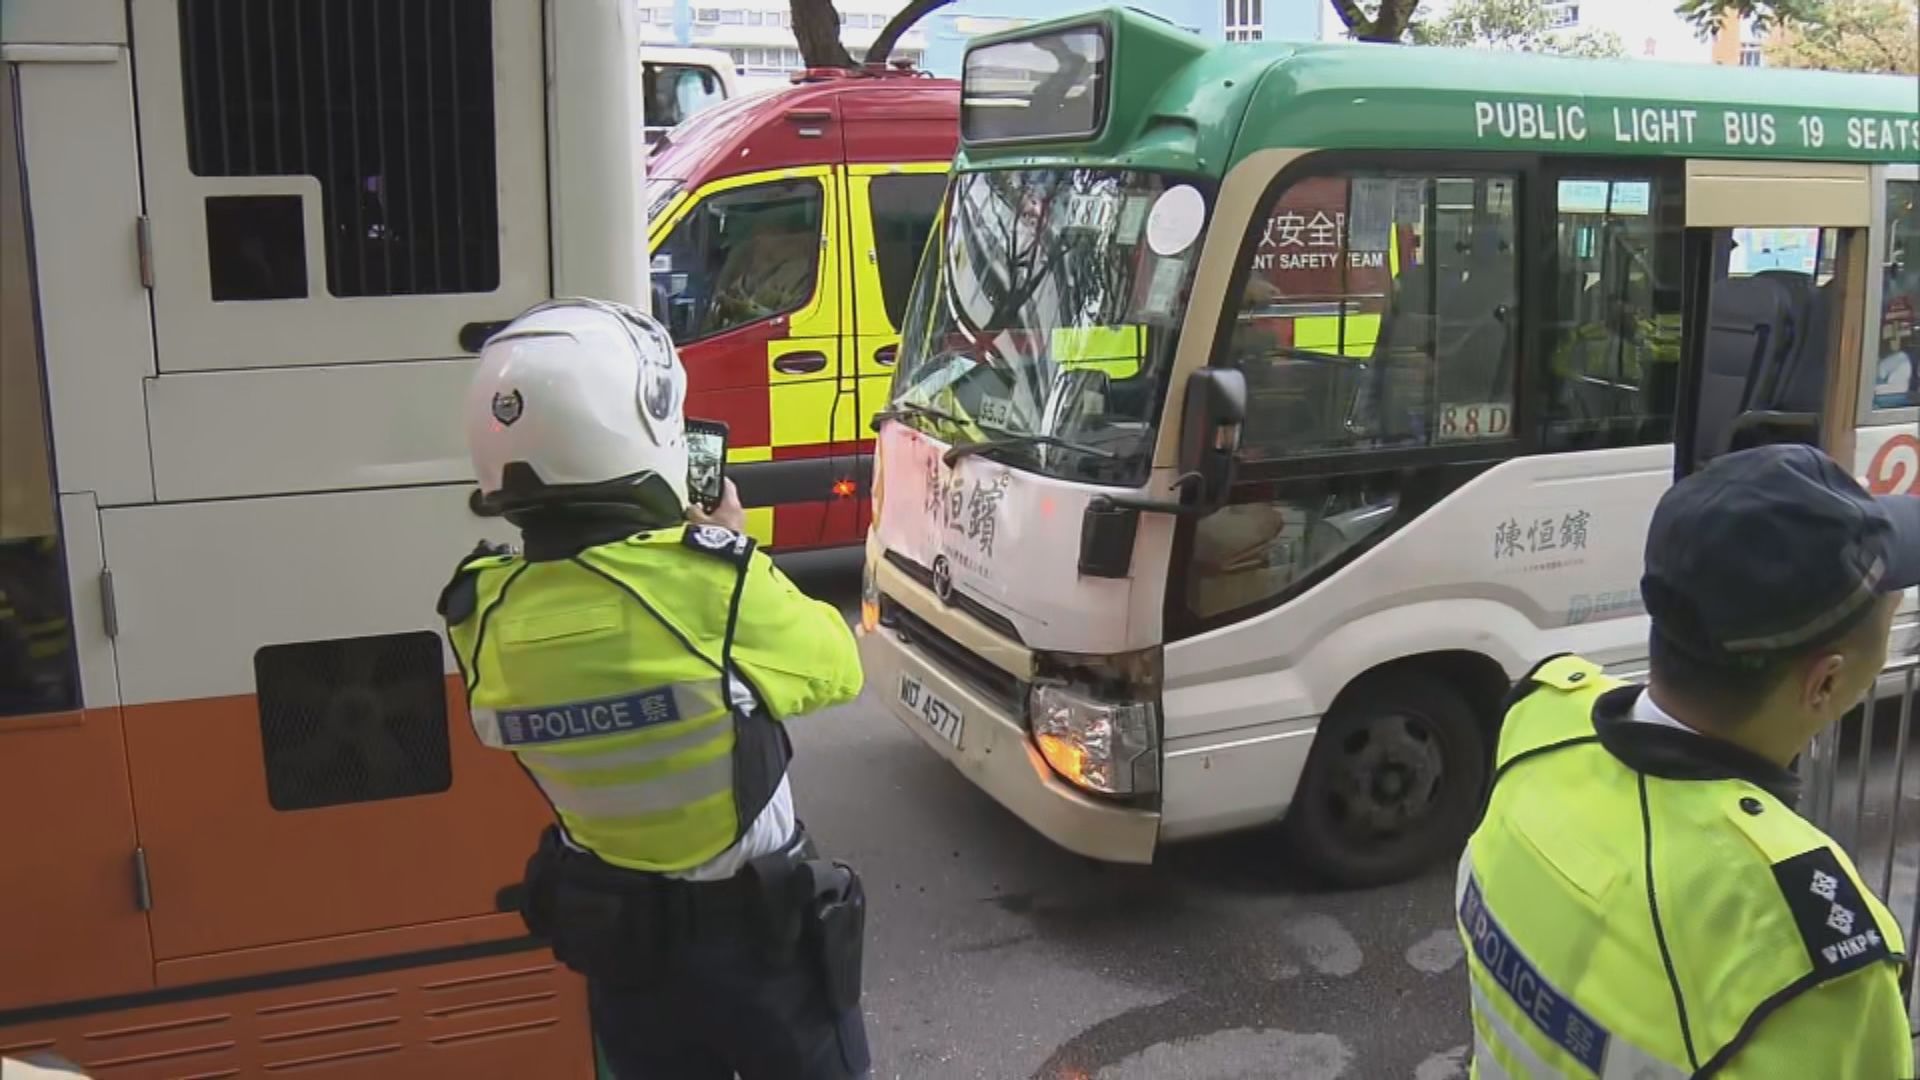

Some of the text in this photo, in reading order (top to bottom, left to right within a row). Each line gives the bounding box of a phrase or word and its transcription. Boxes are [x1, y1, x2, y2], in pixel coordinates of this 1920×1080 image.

[1475, 101, 1587, 141] PUBLIC
[1613, 106, 1697, 143] LIGHT
[1723, 111, 1776, 145] BUS
[1798, 115, 1824, 147] 19
[1259, 210, 1345, 247] 安全
[1252, 253, 1275, 269] NT
[1280, 253, 1339, 269] SAFETY
[1443, 407, 1507, 435] 88D
[527, 701, 633, 739] POLICE
[922, 695, 959, 738] 4577
[1474, 912, 1555, 1031] POLICE
